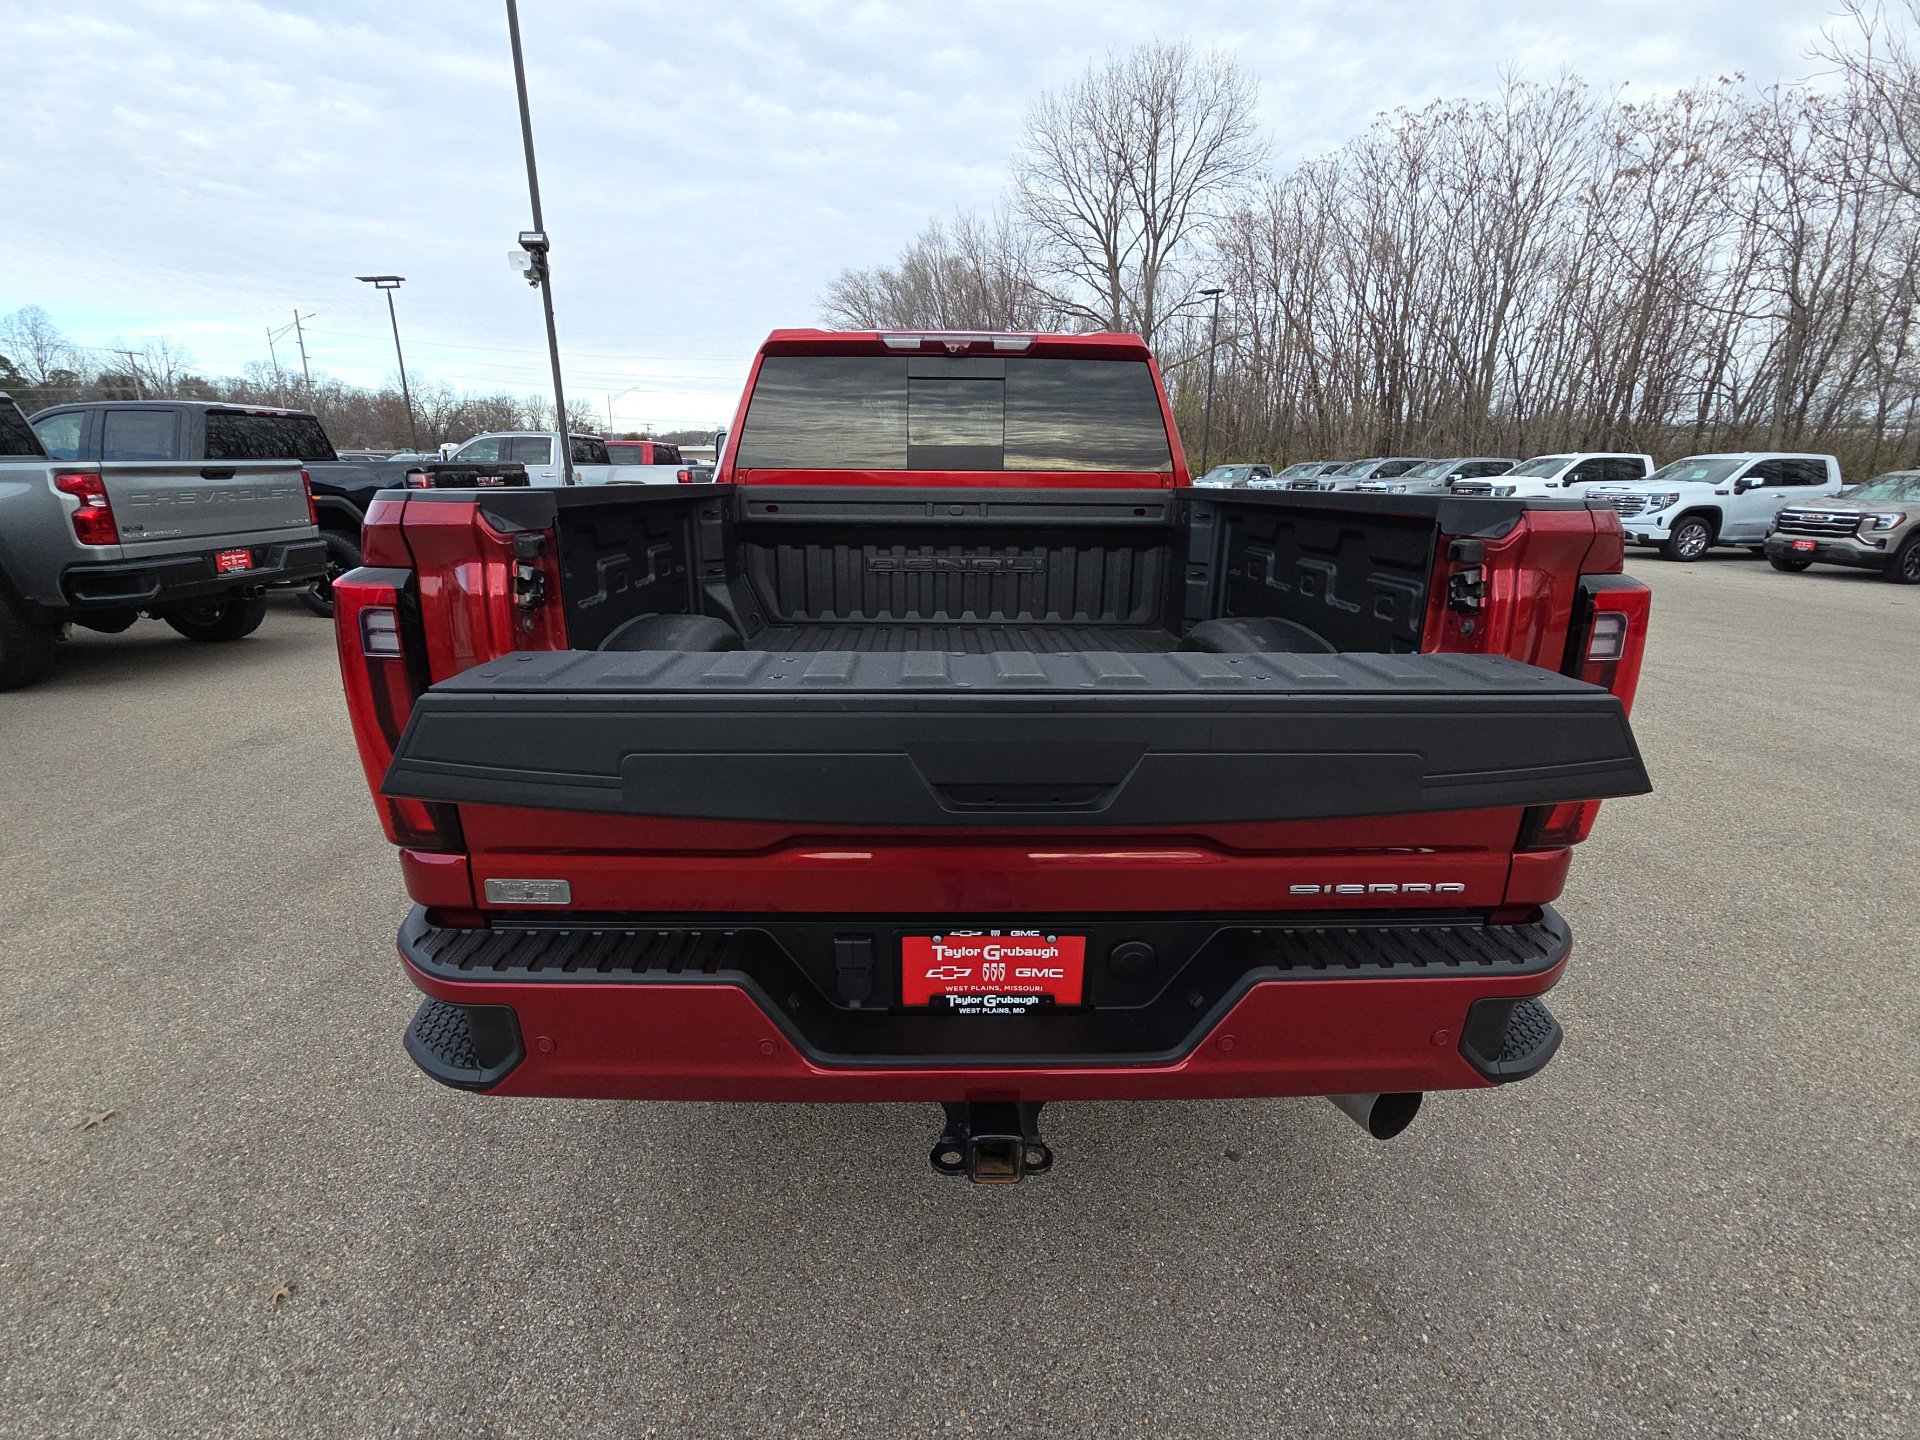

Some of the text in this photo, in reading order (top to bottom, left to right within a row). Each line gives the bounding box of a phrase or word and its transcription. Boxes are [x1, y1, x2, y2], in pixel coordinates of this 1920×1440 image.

[130, 488, 298, 507] CHEVROLET
[1289, 882, 1465, 895] SIERRA
[931, 944, 1059, 961] Taylor Grubaugh
[1015, 968, 1064, 978] GMC
[946, 994, 1039, 1007] Taylor Grubaugh
[982, 1007, 1012, 1015] PLAINS,
